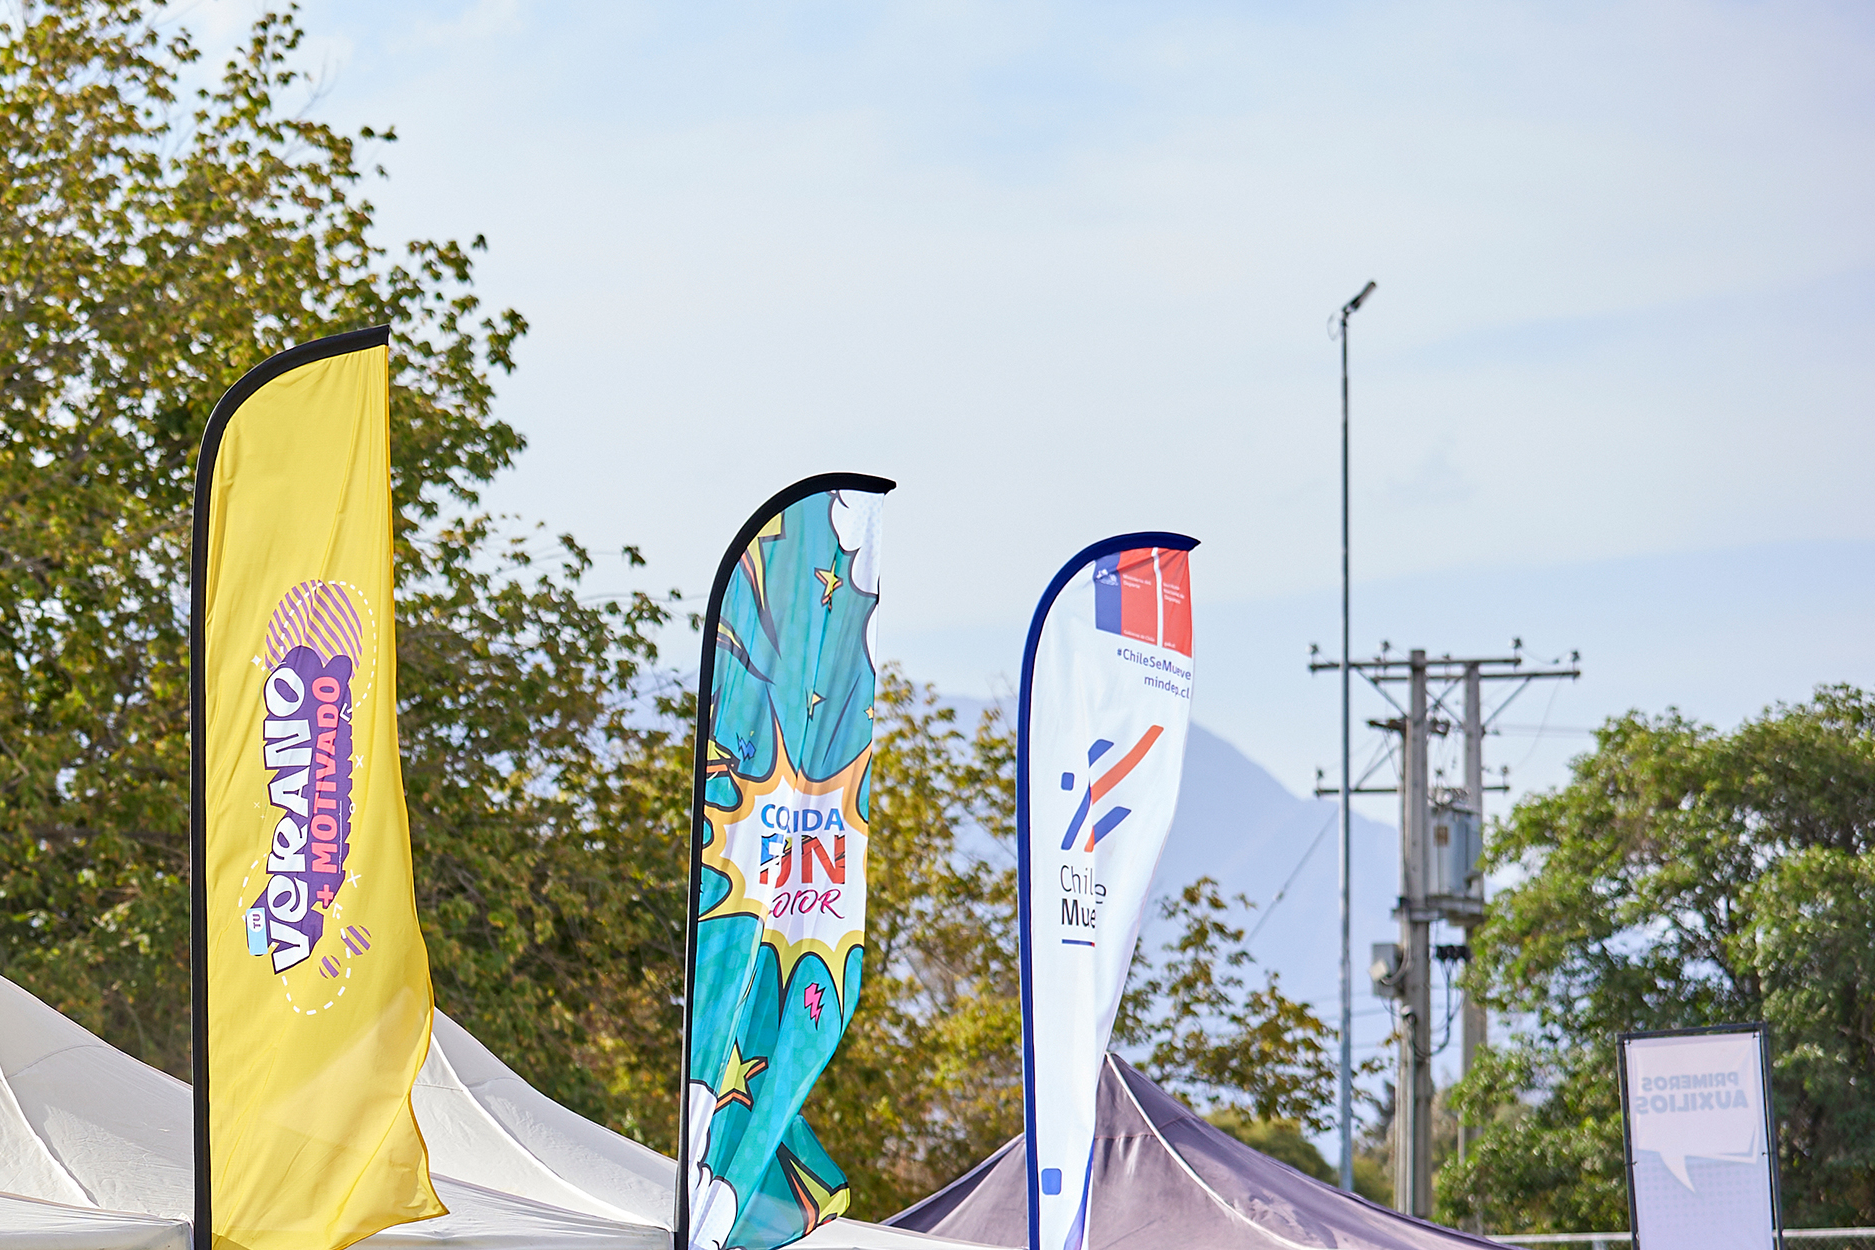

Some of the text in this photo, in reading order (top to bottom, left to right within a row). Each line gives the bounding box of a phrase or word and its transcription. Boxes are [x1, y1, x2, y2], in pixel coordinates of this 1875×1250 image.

[1117, 648, 1191, 680] #ChileSeMueve
[1144, 675, 1190, 699] mindep.cl
[311, 676, 341, 873] MOTIVADO
[252, 913, 261, 929] TU
[1061, 898, 1096, 929] Mue
